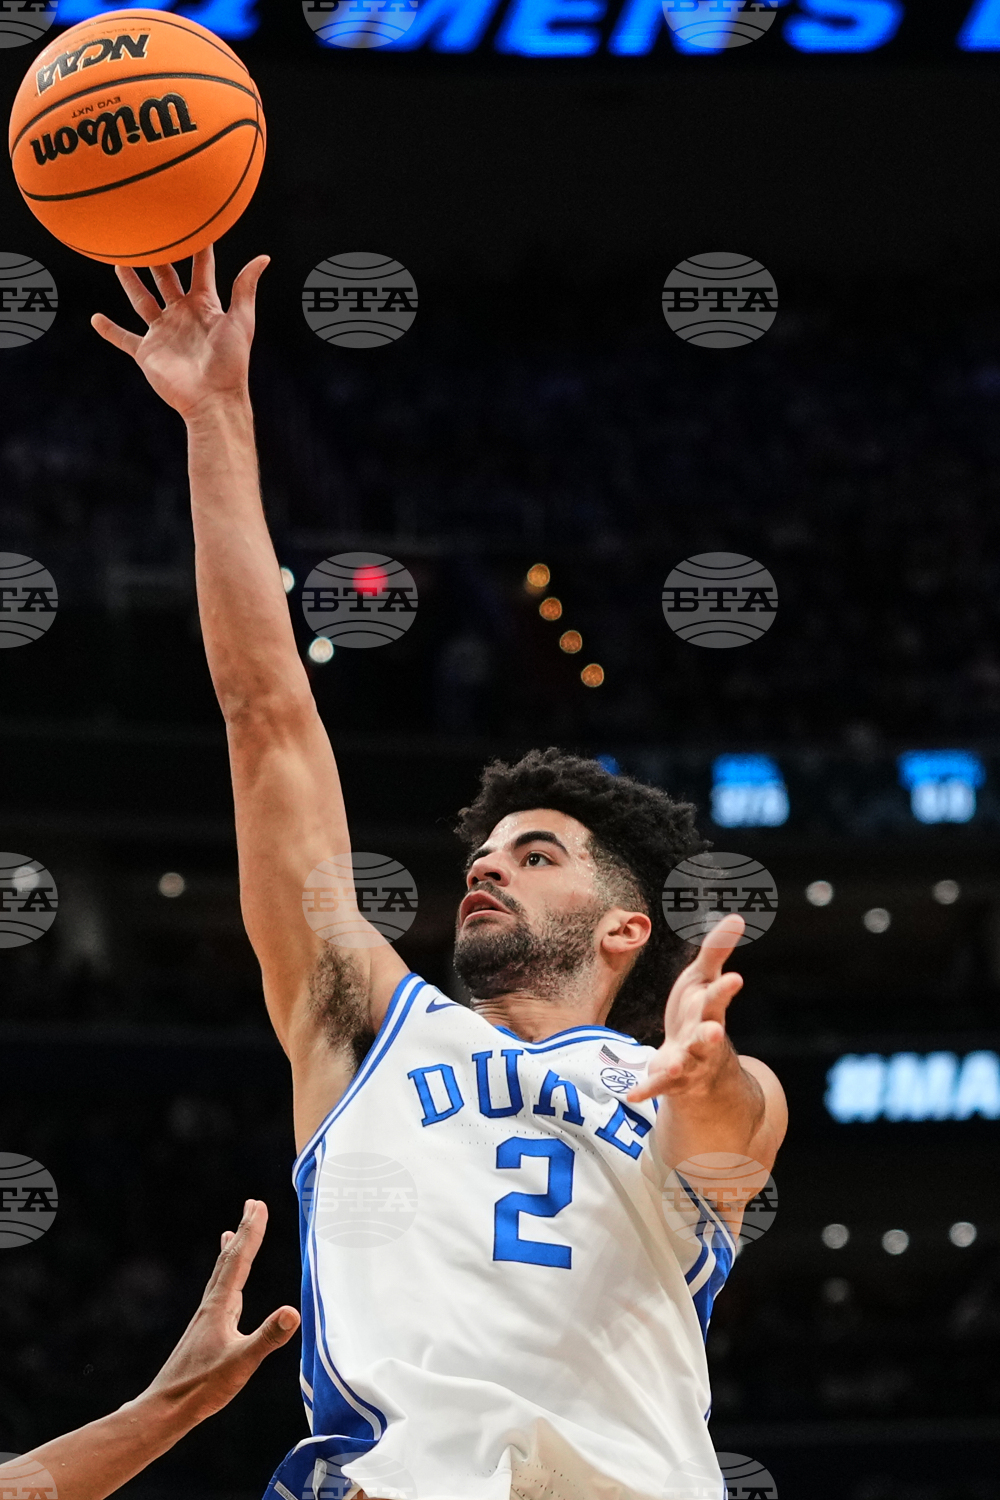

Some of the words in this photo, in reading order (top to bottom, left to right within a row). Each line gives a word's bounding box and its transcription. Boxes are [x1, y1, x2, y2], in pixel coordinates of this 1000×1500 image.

[35, 33, 151, 96] NCAA
[30, 92, 197, 166] Wilson
[71, 104, 94, 119] NXT
[99, 96, 121, 109] EVO
[493, 1136, 575, 1270] 2
